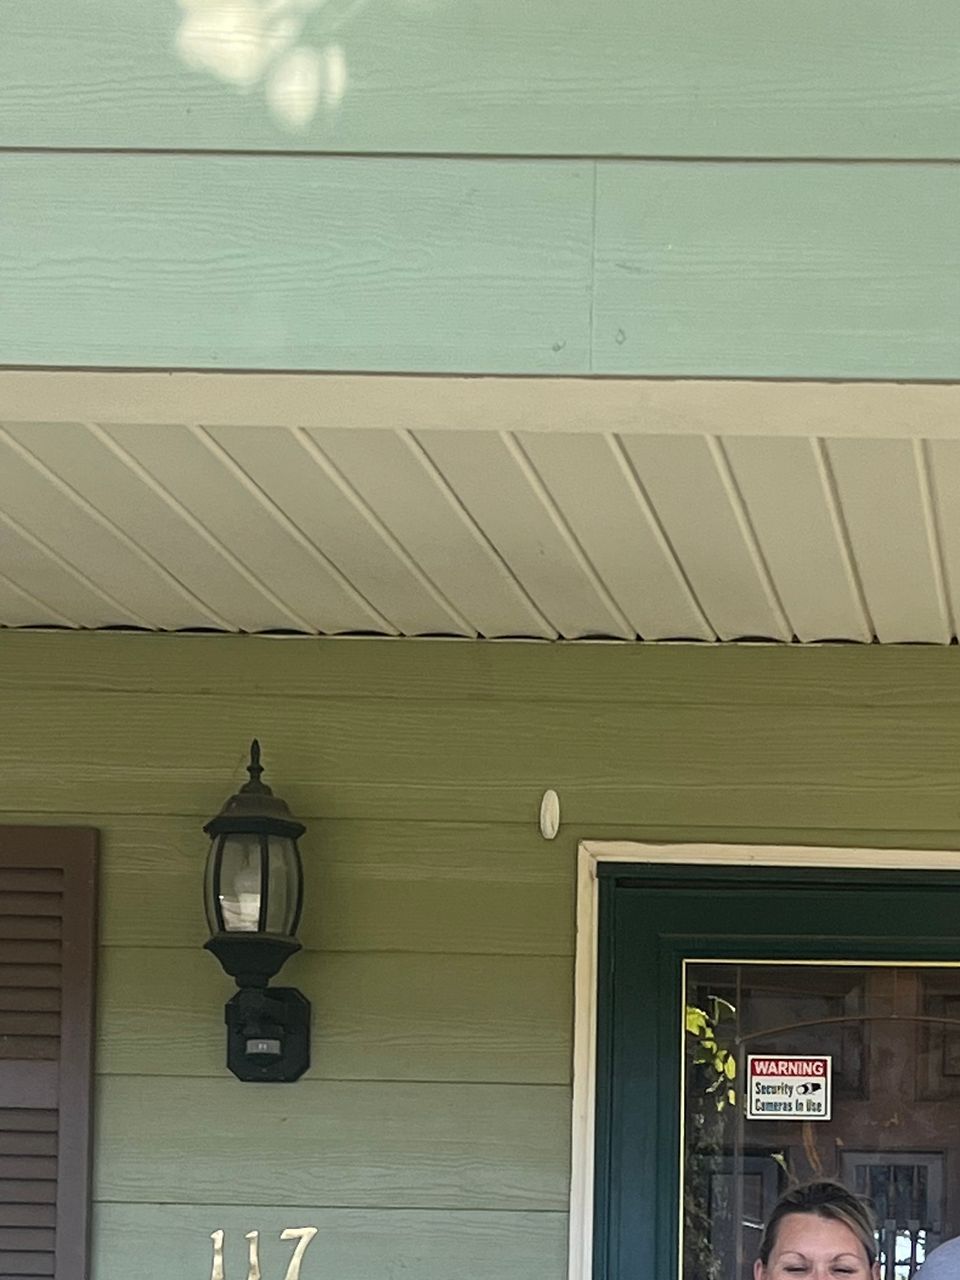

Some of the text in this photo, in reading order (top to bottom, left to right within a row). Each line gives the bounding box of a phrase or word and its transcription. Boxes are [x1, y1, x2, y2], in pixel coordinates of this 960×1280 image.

[754, 1060, 824, 1076] WARNING
[755, 1081, 794, 1098] Security
[755, 1098, 793, 1112] Cameras
[806, 1099, 822, 1113] Use
